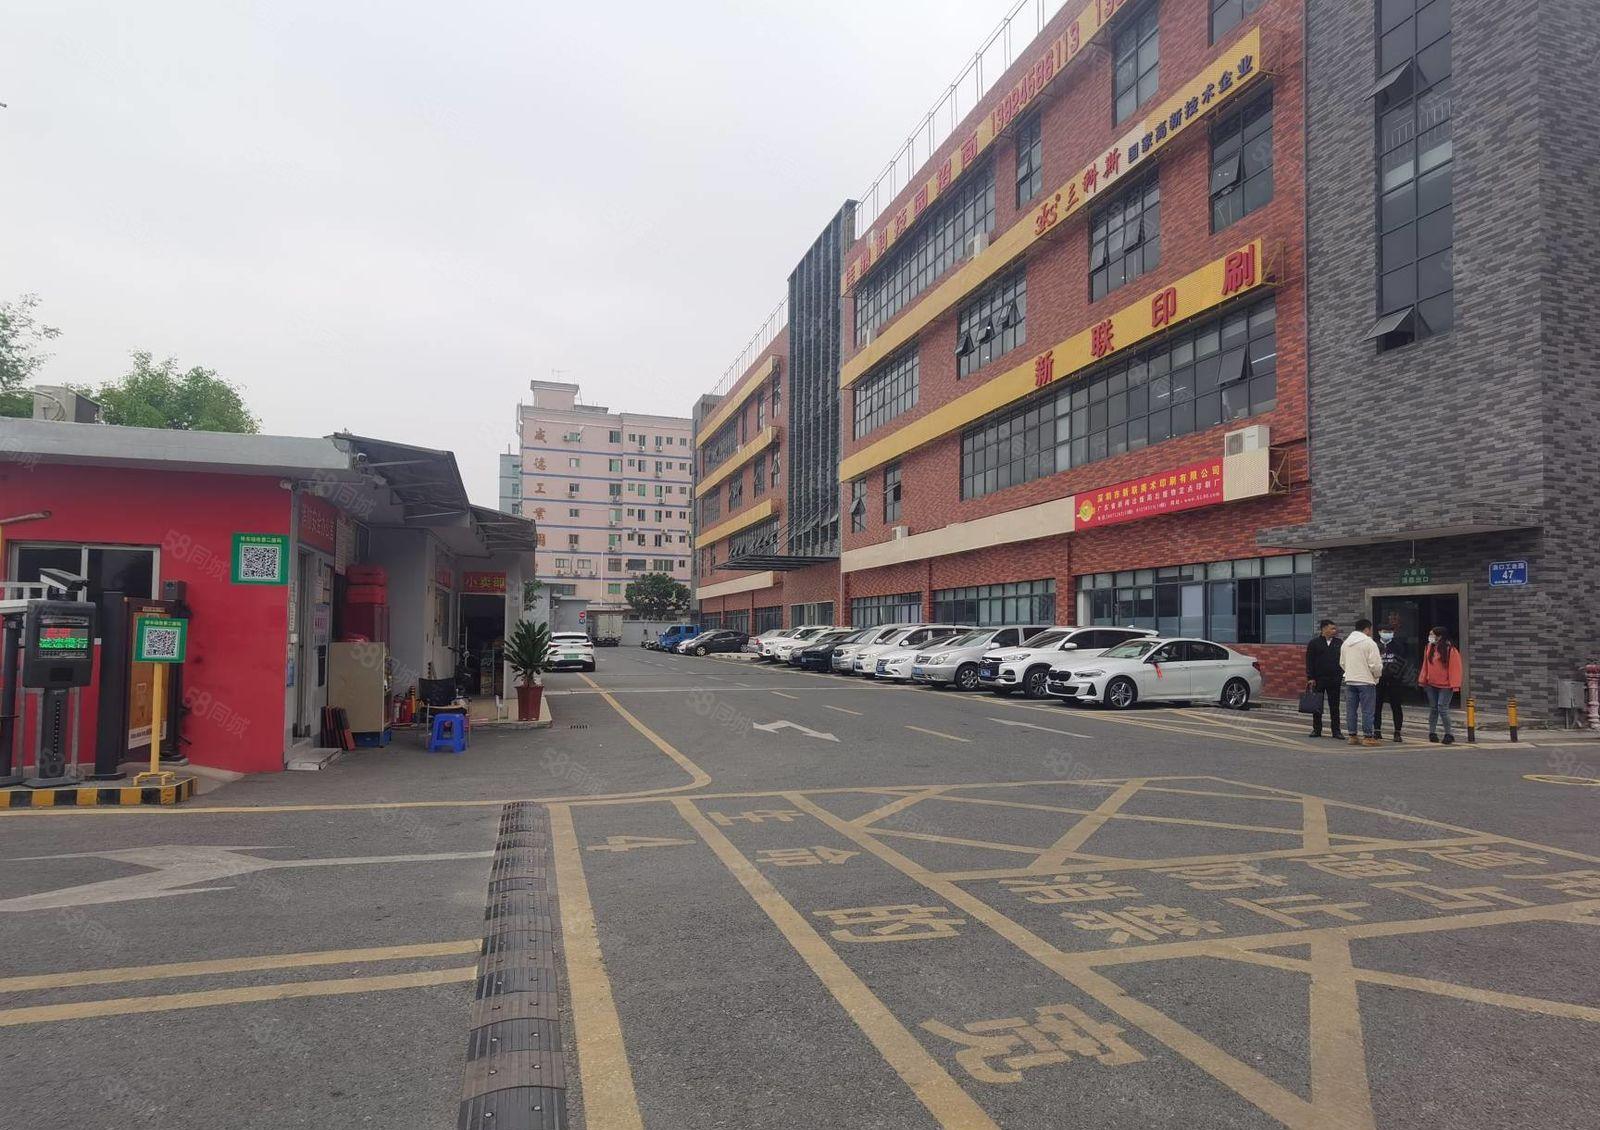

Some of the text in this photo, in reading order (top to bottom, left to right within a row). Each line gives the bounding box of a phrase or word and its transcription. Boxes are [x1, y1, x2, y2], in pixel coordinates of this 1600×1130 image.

[1128, 55, 1253, 164] 国家高新技术企业
[1035, 244, 1255, 387] 新联印刷
[464, 575, 505, 589] 小卖部
[1502, 570, 1514, 579] 47
[998, 843, 1549, 905] 消防通道
